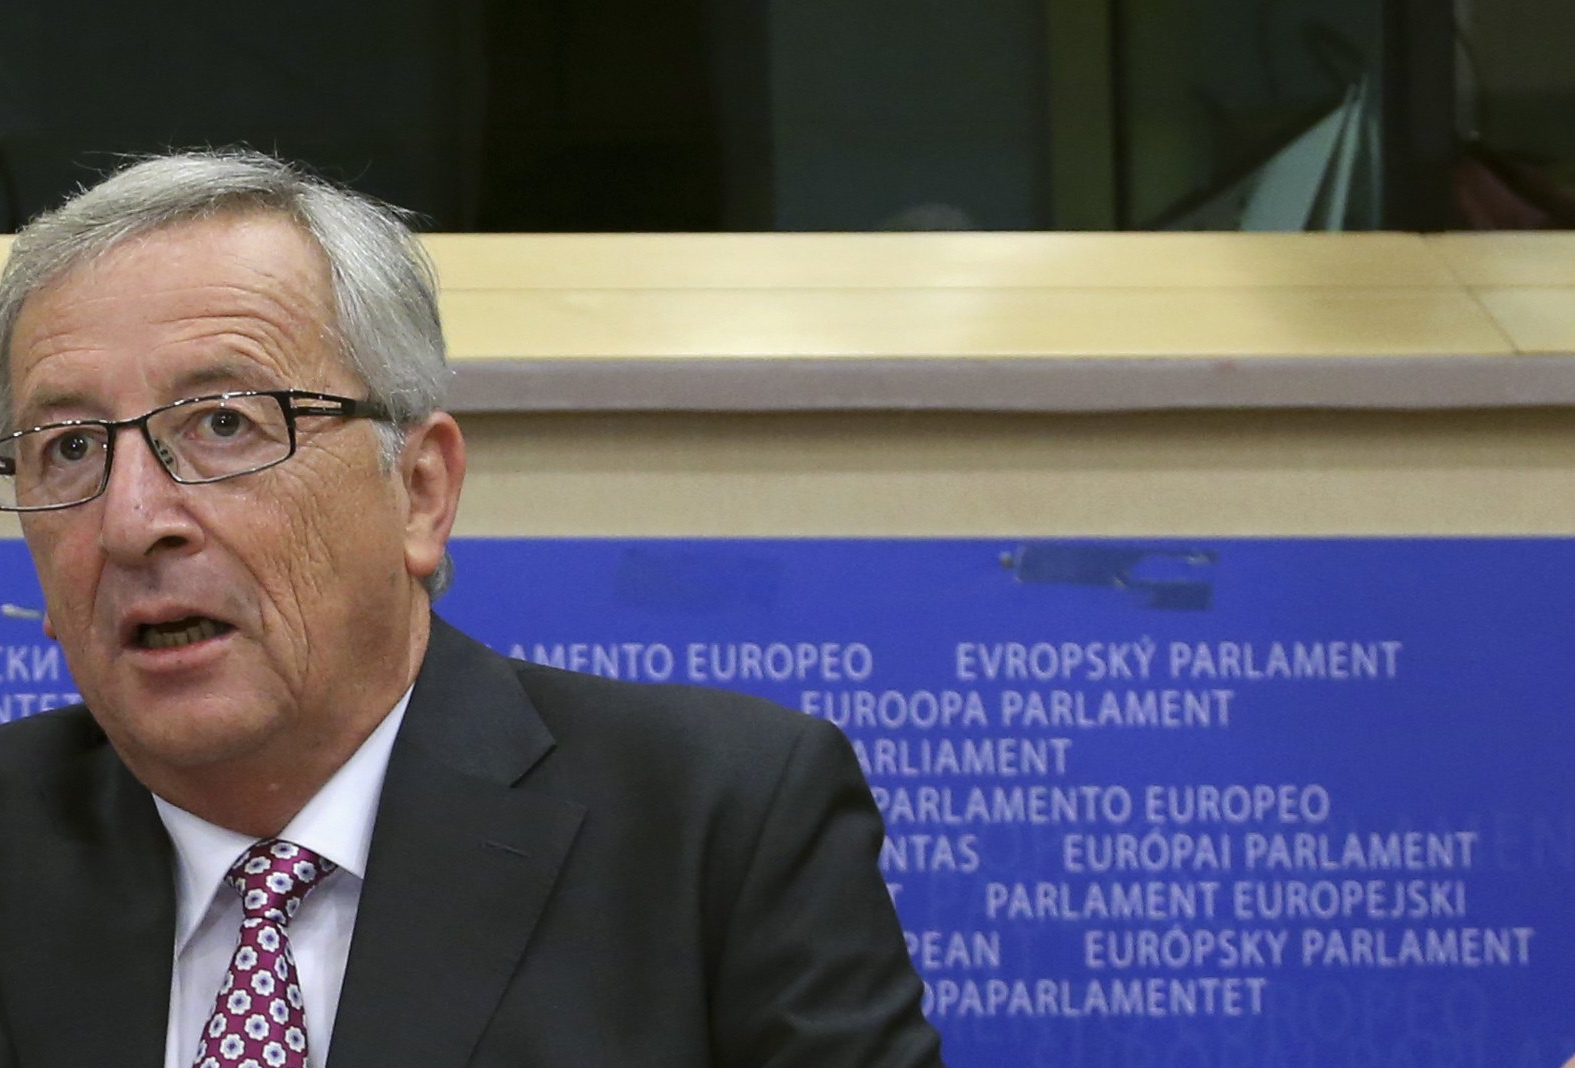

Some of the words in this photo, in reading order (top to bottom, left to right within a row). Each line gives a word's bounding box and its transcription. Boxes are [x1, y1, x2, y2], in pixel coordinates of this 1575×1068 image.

[687, 642, 873, 681] EUROPEO
[956, 635, 1156, 680] EVROPSKÝ
[1169, 641, 1401, 679] PARLAMENT
[801, 690, 988, 729] EUROOPA
[1001, 689, 1234, 728] PARLAMENT
[871, 785, 1132, 825] PARLAMENTO
[1145, 784, 1330, 824] EUROPEO
[1063, 826, 1231, 871] EURÓPAI
[1245, 831, 1475, 870] PARLAMENT
[986, 881, 1219, 920] PARLAMENT
[1234, 880, 1465, 919] EUROPEJSKI
[1085, 924, 1287, 968] EURÓPSKY
[1302, 927, 1531, 966] PARLAMENT
